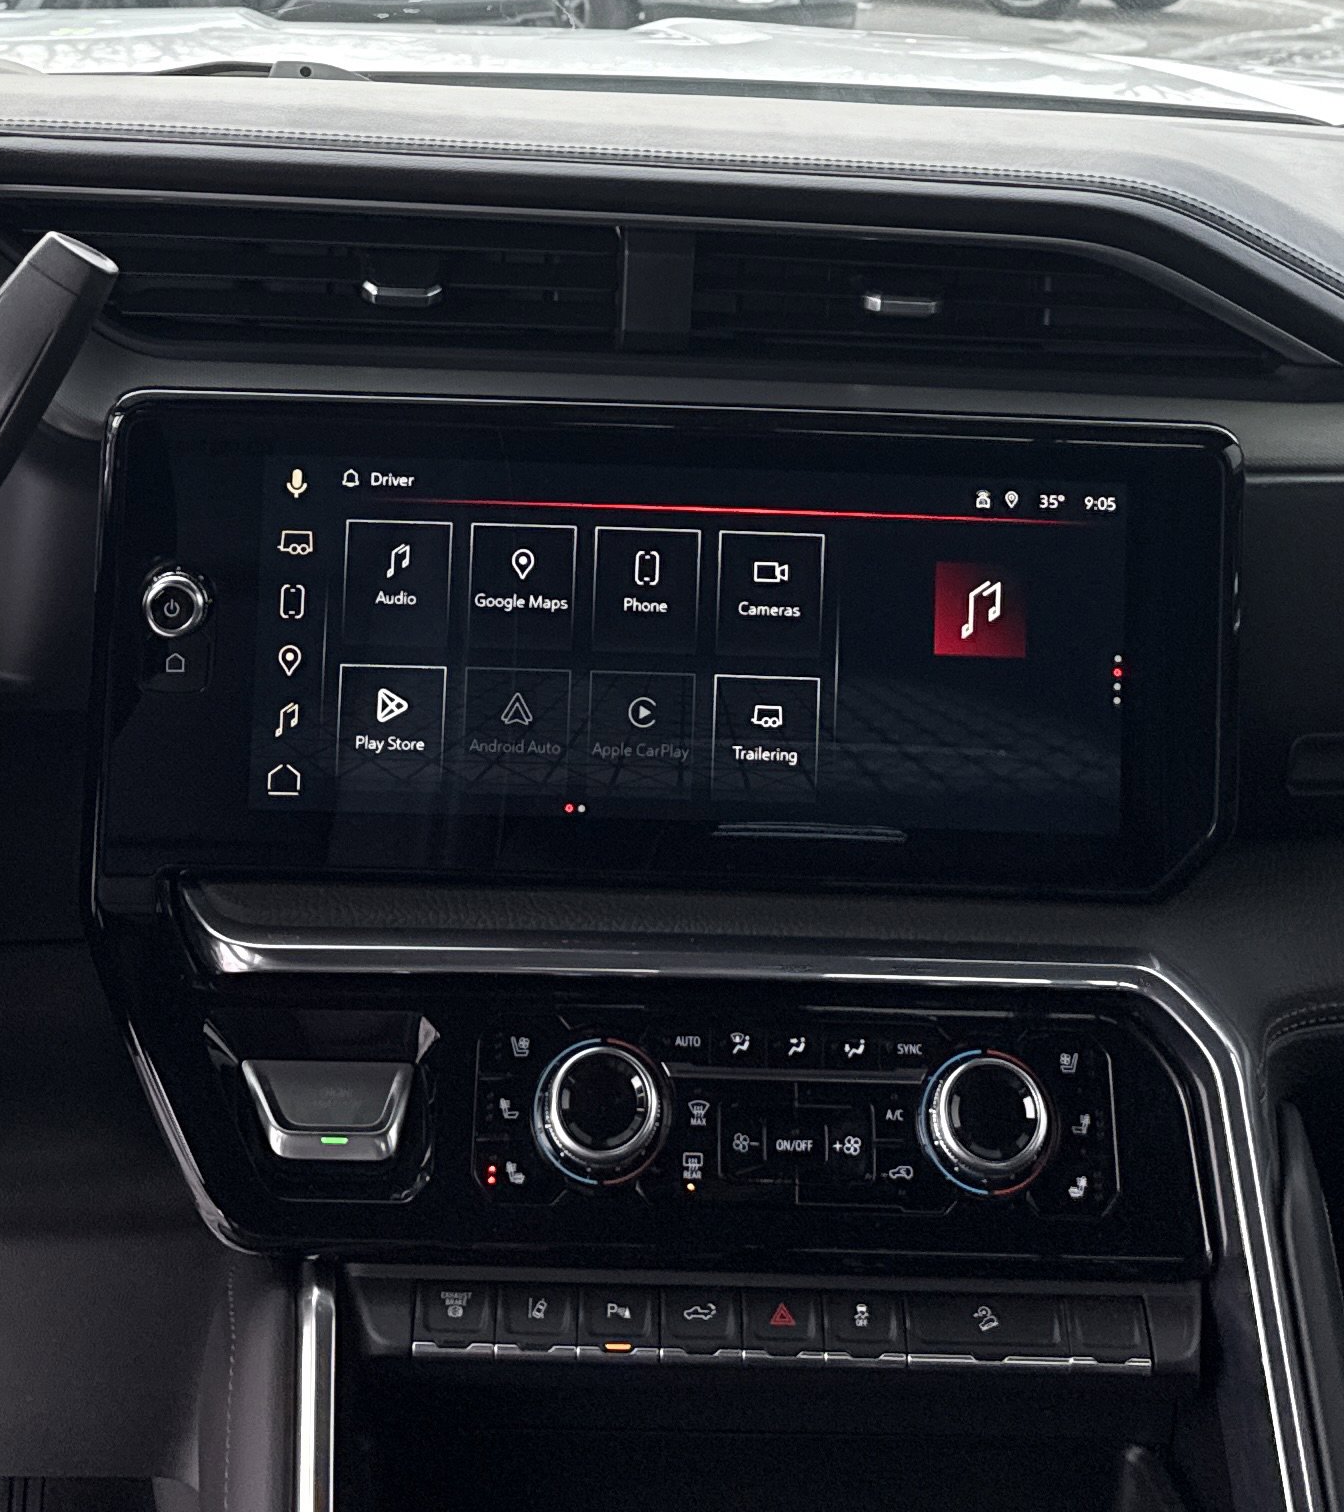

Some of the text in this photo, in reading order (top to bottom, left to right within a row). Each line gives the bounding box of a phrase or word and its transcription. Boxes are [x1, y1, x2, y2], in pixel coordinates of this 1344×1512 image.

[370, 471, 415, 487] Driver
[1039, 494, 1066, 509] 35°
[1084, 496, 1117, 511] 9:05
[375, 590, 417, 606] Audio
[474, 592, 569, 613] Google Maps
[622, 597, 668, 613] Phone
[737, 601, 802, 618] Cameras
[354, 735, 425, 754] Play Store
[469, 738, 561, 755] Android Auto
[591, 741, 690, 763] Apple CarPlay
[731, 745, 798, 766] Trailering
[674, 1035, 701, 1047] AUTO
[896, 1043, 923, 1055] SYNC
[689, 1117, 707, 1126] MAX
[885, 1109, 904, 1121] A/C
[775, 1139, 813, 1152] ON/OFF
[682, 1170, 702, 1179] REAR
